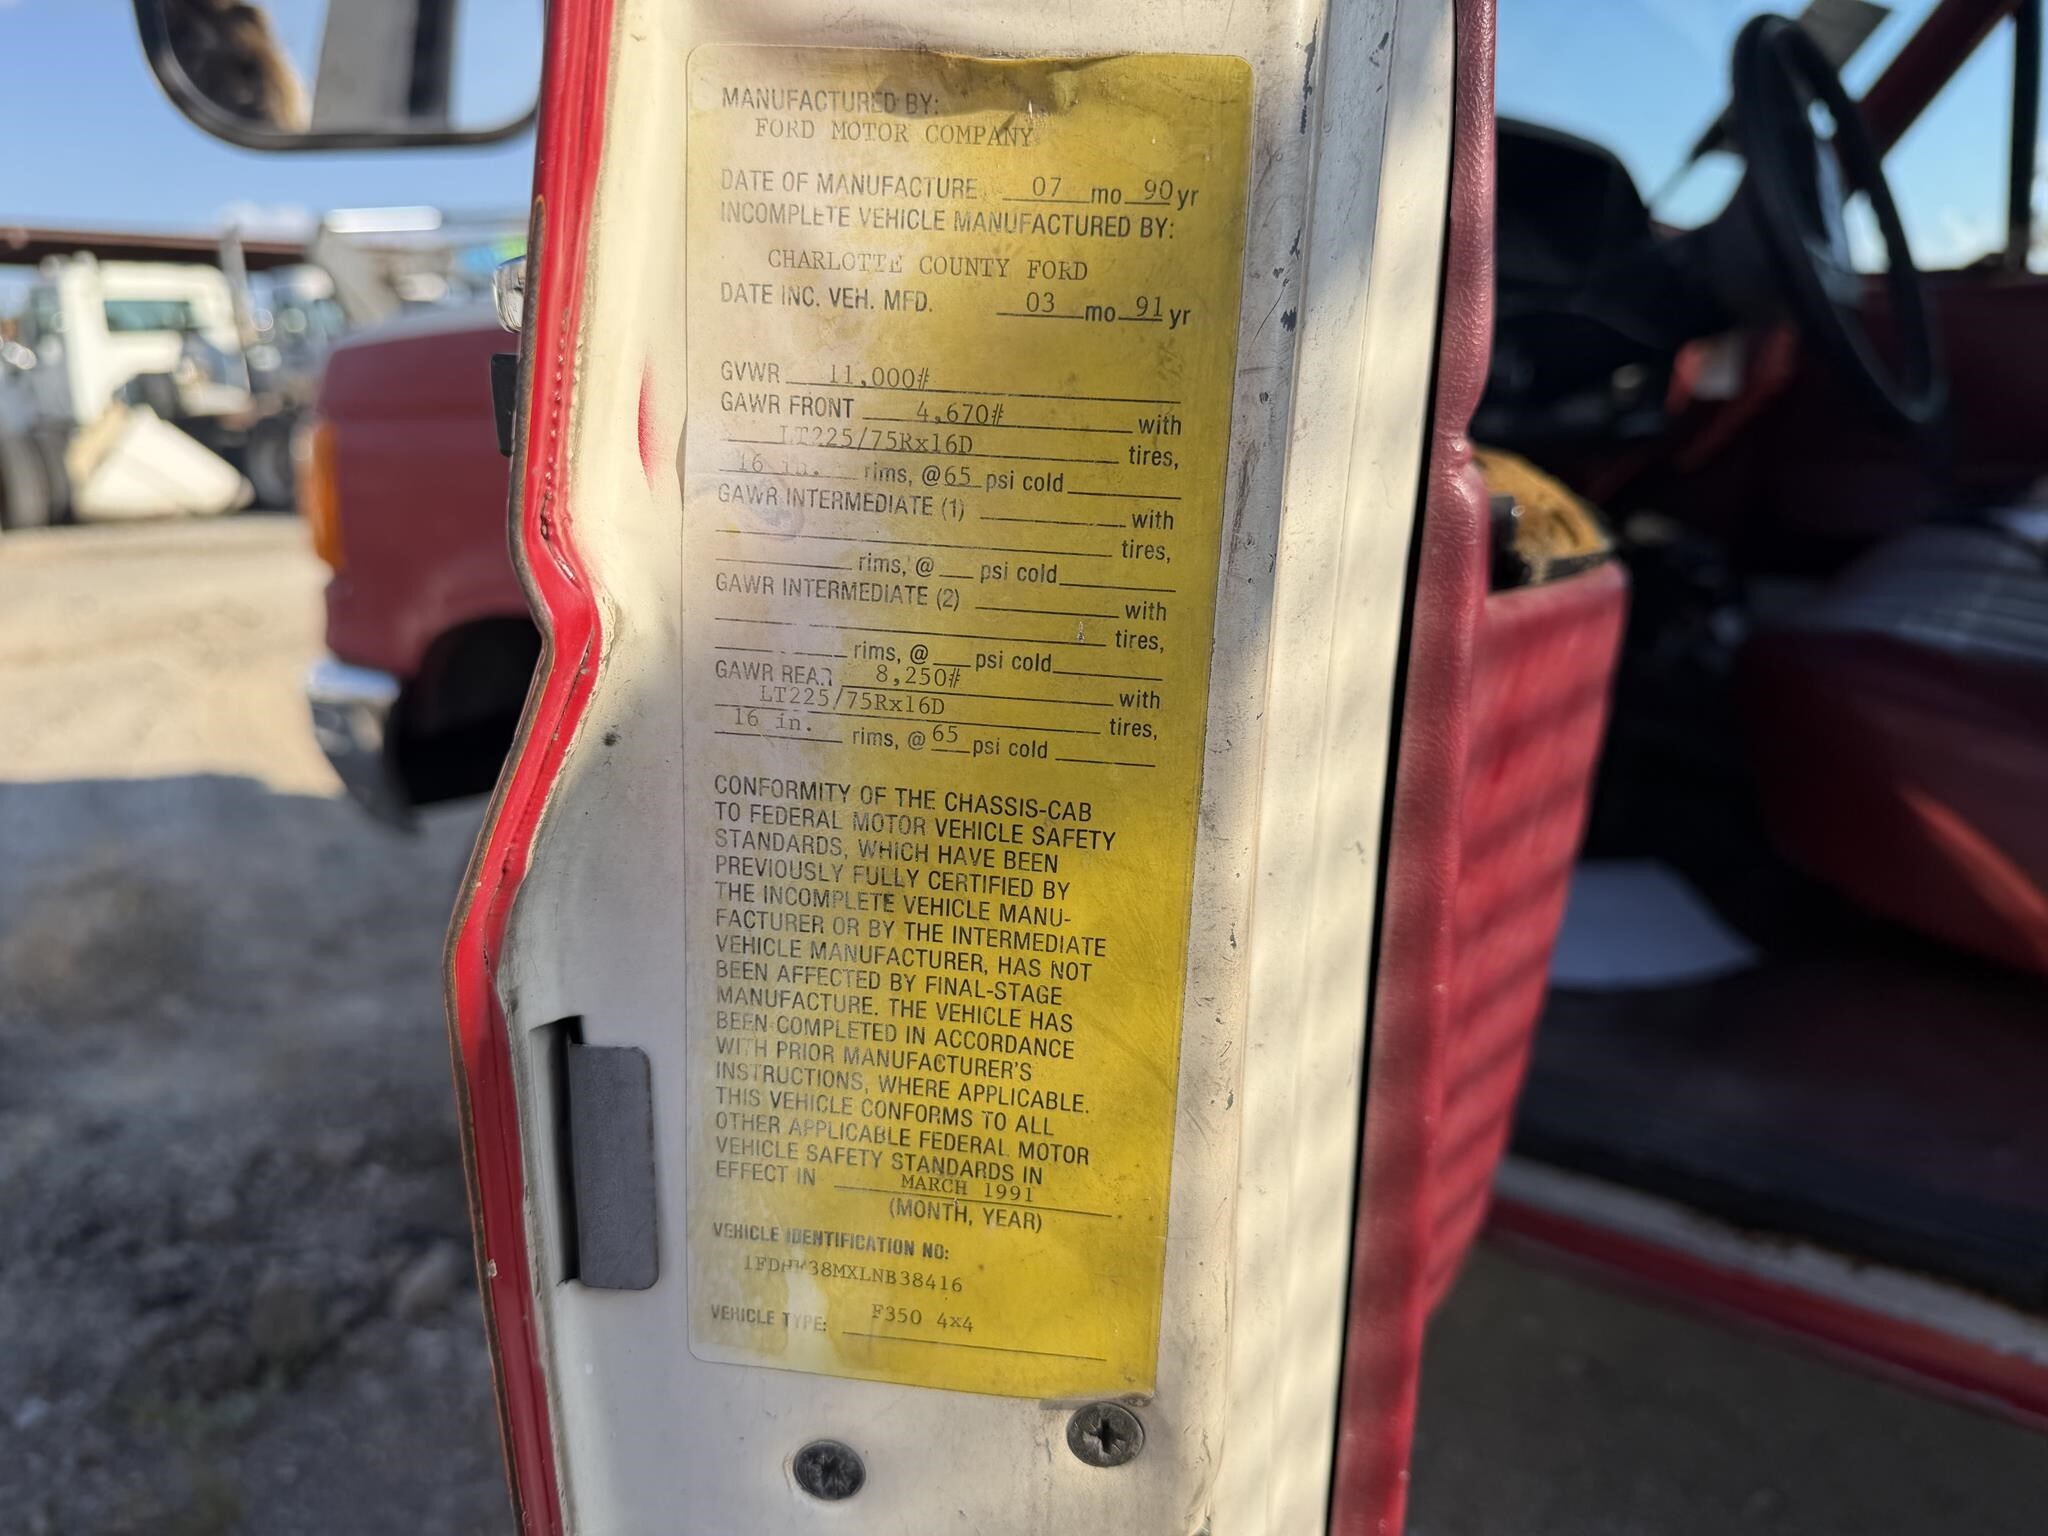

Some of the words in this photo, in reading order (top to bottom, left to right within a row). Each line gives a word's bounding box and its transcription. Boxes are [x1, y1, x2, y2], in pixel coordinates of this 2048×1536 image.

[722, 87, 897, 113] MANUFACTURED
[905, 93, 940, 115] BY:
[754, 118, 814, 140] FORD
[831, 122, 909, 143] MOTOR
[925, 124, 1034, 147] COMPANY
[721, 169, 774, 192] DATE
[781, 172, 808, 193] OF
[817, 173, 978, 200] MANUFACTURE
[1032, 176, 1062, 197] 07
[1090, 186, 1122, 205] mo
[1144, 180, 1174, 200] 90
[1177, 187, 1199, 210] yr
[720, 202, 848, 228] INCOMPLETE
[859, 207, 945, 231] VEHICLE
[954, 211, 1130, 238] MANUFACTURED
[1140, 217, 1174, 239] BY:
[768, 249, 903, 273] CHARLOTTE
[918, 257, 1010, 278] COUNTY
[1027, 260, 1088, 281] FORD
[720, 282, 775, 304] DATE
[781, 284, 820, 306] INC.
[829, 287, 874, 309] VEH.
[884, 290, 933, 312] MFD.
[1026, 292, 1055, 312] 03
[1085, 303, 1116, 322] mo
[1135, 297, 1163, 317] 91
[1169, 307, 1191, 328] yr
[721, 361, 780, 384] GVWR
[830, 365, 930, 389] 11,000#
[720, 393, 781, 415] GAWR
[789, 397, 855, 419] FRONT
[916, 403, 1004, 425] 4,670#
[1139, 414, 1182, 435] with
[738, 454, 763, 473] 16
[864, 464, 913, 486] rims,
[985, 470, 1014, 491] psi
[1023, 473, 1064, 493] cold
[1128, 446, 1179, 470] tires,
[718, 484, 781, 508] GAWR
[786, 487, 933, 516] INTERMEDIATE
[941, 499, 965, 522] (1)
[1131, 509, 1174, 531] with
[858, 555, 908, 578] rims,
[915, 558, 935, 577] @
[980, 563, 1008, 583] psi
[1017, 564, 1057, 585] cold
[1121, 541, 1171, 563] tires,
[715, 573, 775, 596] GAWR
[782, 577, 929, 607] INTERMEDIATE
[936, 588, 960, 611] (2)
[1125, 601, 1167, 622] with
[854, 642, 901, 664] rims,
[910, 645, 929, 664] @
[975, 652, 1004, 672] psi
[1013, 653, 1051, 673] cold
[1115, 630, 1165, 652] tires,
[715, 660, 774, 683] GAWR
[875, 665, 960, 687] 8,250#
[1119, 690, 1161, 710] with
[733, 709, 759, 728] 16
[775, 711, 812, 732] in.
[852, 727, 899, 750] rims,
[908, 731, 926, 751] @
[972, 737, 1000, 757] psi
[1008, 739, 1048, 760] cold
[1109, 719, 1157, 740] tires,
[714, 774, 851, 803] CONFORMITY
[860, 785, 886, 805] OF
[895, 788, 935, 809] THE
[944, 792, 1092, 822] CHASSIS-CAB
[715, 801, 741, 822] TO
[750, 804, 842, 830] FEDERAL
[852, 812, 926, 836] MOTOR
[935, 818, 1023, 844] VEHICLE
[1032, 825, 1116, 851] SAFETY
[715, 828, 848, 860] STANDARDS,
[859, 839, 928, 863] WHICH
[938, 845, 994, 869] HAVE
[1004, 849, 1059, 874] BEEN
[715, 855, 844, 883] PREVIOUSLY
[853, 866, 919, 889] FULLY
[928, 871, 1034, 898] CERTIFIED
[1043, 879, 1071, 901] BY
[715, 881, 754, 902] THE
[763, 884, 895, 914] INCOMPLETE
[904, 894, 991, 921] VEHICLE
[999, 901, 1071, 928] MANU-
[715, 908, 825, 934] FACTURER
[832, 914, 859, 936] OR
[869, 919, 895, 940] BY
[904, 921, 944, 943] THE
[952, 924, 1107, 957] INTERMEDIATE
[715, 934, 801, 958] VEHICLE
[810, 942, 988, 976] MANUFACTURER,
[998, 956, 1041, 978] HAS
[1050, 960, 1092, 982] NOT
[716, 959, 768, 983] BEEN
[777, 965, 881, 990] AFFECTED
[890, 972, 916, 992] BY
[925, 976, 1062, 1005] FINAL-STAGE
[716, 987, 878, 1017] MANUFACTURE.
[889, 999, 927, 1020] THE
[936, 1002, 1021, 1028] VEHICLE
[1030, 1010, 1073, 1033] HAS
[715, 1036, 767, 1057] WITH
[776, 1042, 835, 1062] PRIOR
[716, 1012, 765, 1032] BEEN
[776, 1016, 897, 1043] COMPLETED
[905, 1026, 926, 1045] IN
[935, 1028, 1075, 1059] ACCORDANCE
[716, 1061, 869, 1094] INSTRUCTIONS,
[879, 1076, 950, 1099] WHERE
[958, 1083, 1089, 1114] APPLICABLE.
[715, 1087, 761, 1108] THIS
[770, 1091, 852, 1116] VEHICLE
[861, 1099, 973, 1128] CONFORMS
[982, 1109, 1007, 1131] TO
[1015, 1114, 1054, 1136] ALL
[716, 1111, 780, 1134] OTHER
[789, 1118, 911, 1147] APPLICABLE
[919, 1131, 1009, 1158] FEDERAL
[1018, 1140, 1089, 1165] MOTOR
[715, 1136, 798, 1160] VEHICLE
[807, 1143, 882, 1168] SAFETY
[891, 1151, 1015, 1182] STANDARDS
[1023, 1165, 1042, 1185] IN
[716, 1160, 788, 1184] EFFECT
[797, 1167, 816, 1186] IN
[901, 1174, 968, 1196] MARCH
[984, 1183, 1034, 1202] 1991
[889, 1200, 973, 1226] (MONTH,
[983, 1207, 1042, 1233] YEAR)
[714, 1222, 780, 1243] VEHICLE
[787, 1227, 916, 1256] IDENTIFICATION
[922, 1242, 950, 1260] NO:
[711, 1305, 775, 1327] VEHICLE
[782, 1311, 827, 1332] TYPE:
[871, 1304, 922, 1326] F350
[937, 1312, 973, 1333] 4x4
